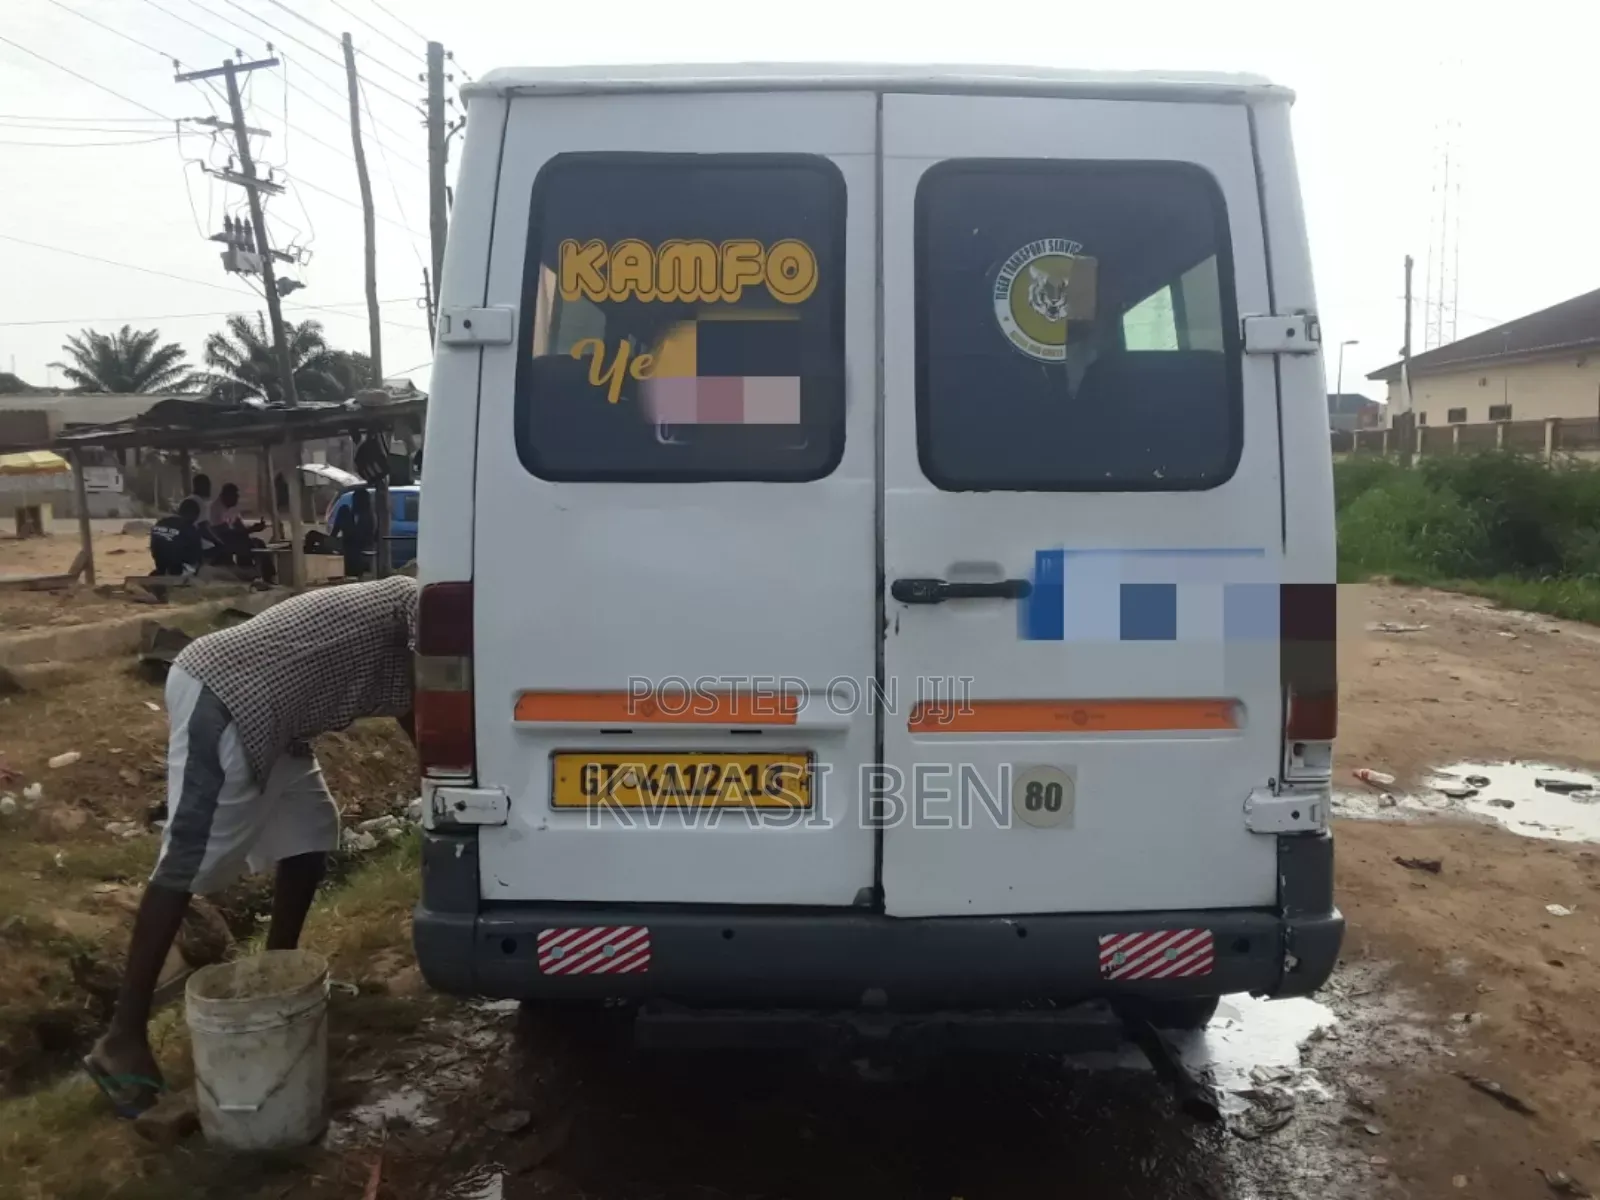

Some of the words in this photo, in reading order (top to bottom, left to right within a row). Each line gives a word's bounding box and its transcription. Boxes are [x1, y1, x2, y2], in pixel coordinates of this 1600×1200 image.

[559, 238, 818, 303] KAMFO
[1002, 239, 1047, 277] TRANSPORT
[1048, 239, 1082, 255] SERVIC
[1025, 781, 1063, 812] 80
